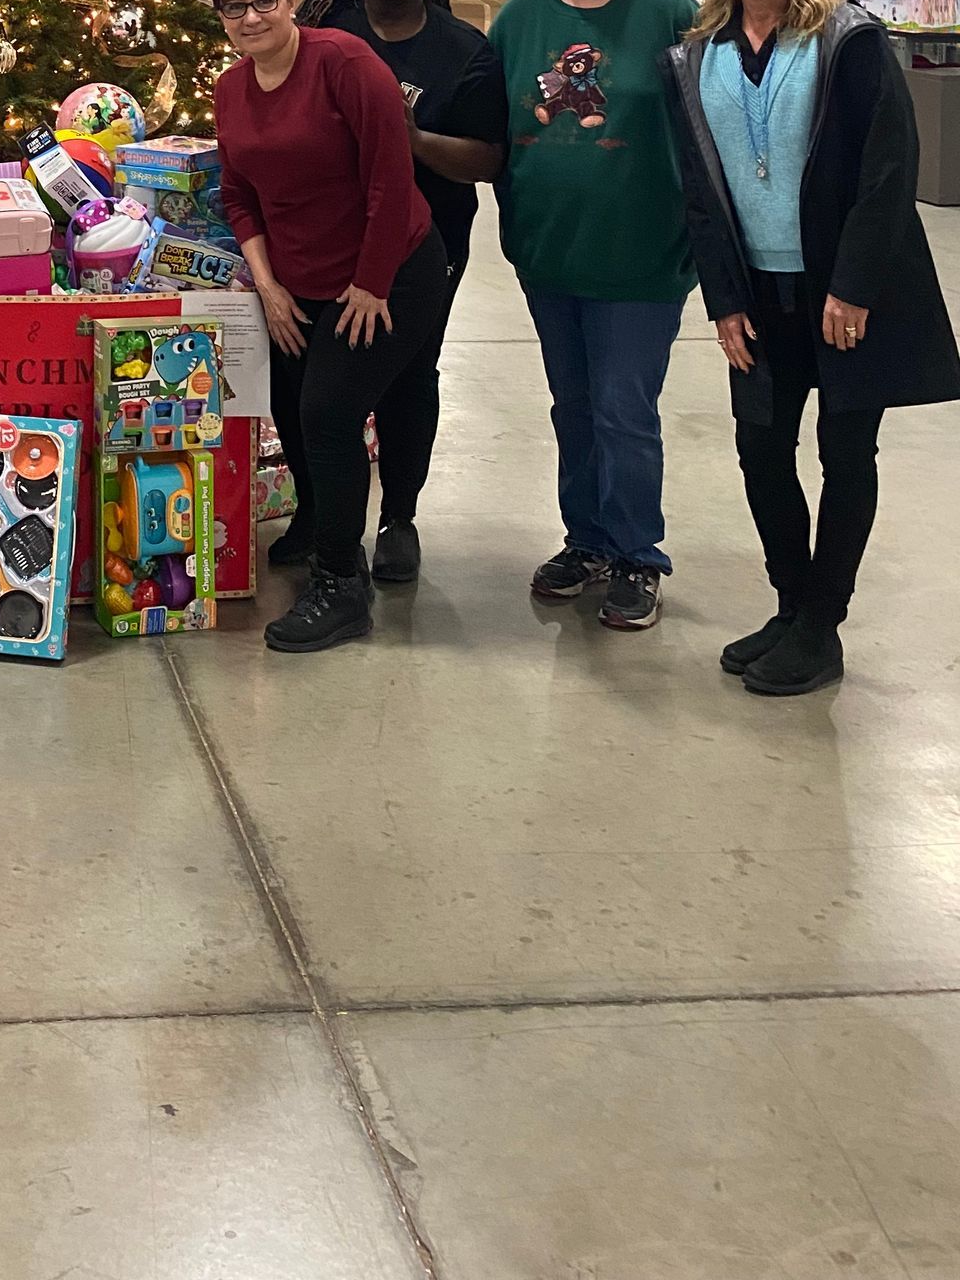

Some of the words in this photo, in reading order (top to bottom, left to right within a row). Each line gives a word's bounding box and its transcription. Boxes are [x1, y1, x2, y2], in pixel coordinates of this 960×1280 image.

[165, 245, 193, 257] DON'T
[160, 253, 192, 267] BREAK
[171, 263, 189, 273] THE
[188, 252, 234, 284] ICE
[150, 326, 179, 338] Dough
[1, 427, 15, 444] 12
[202, 501, 210, 537] Learning
